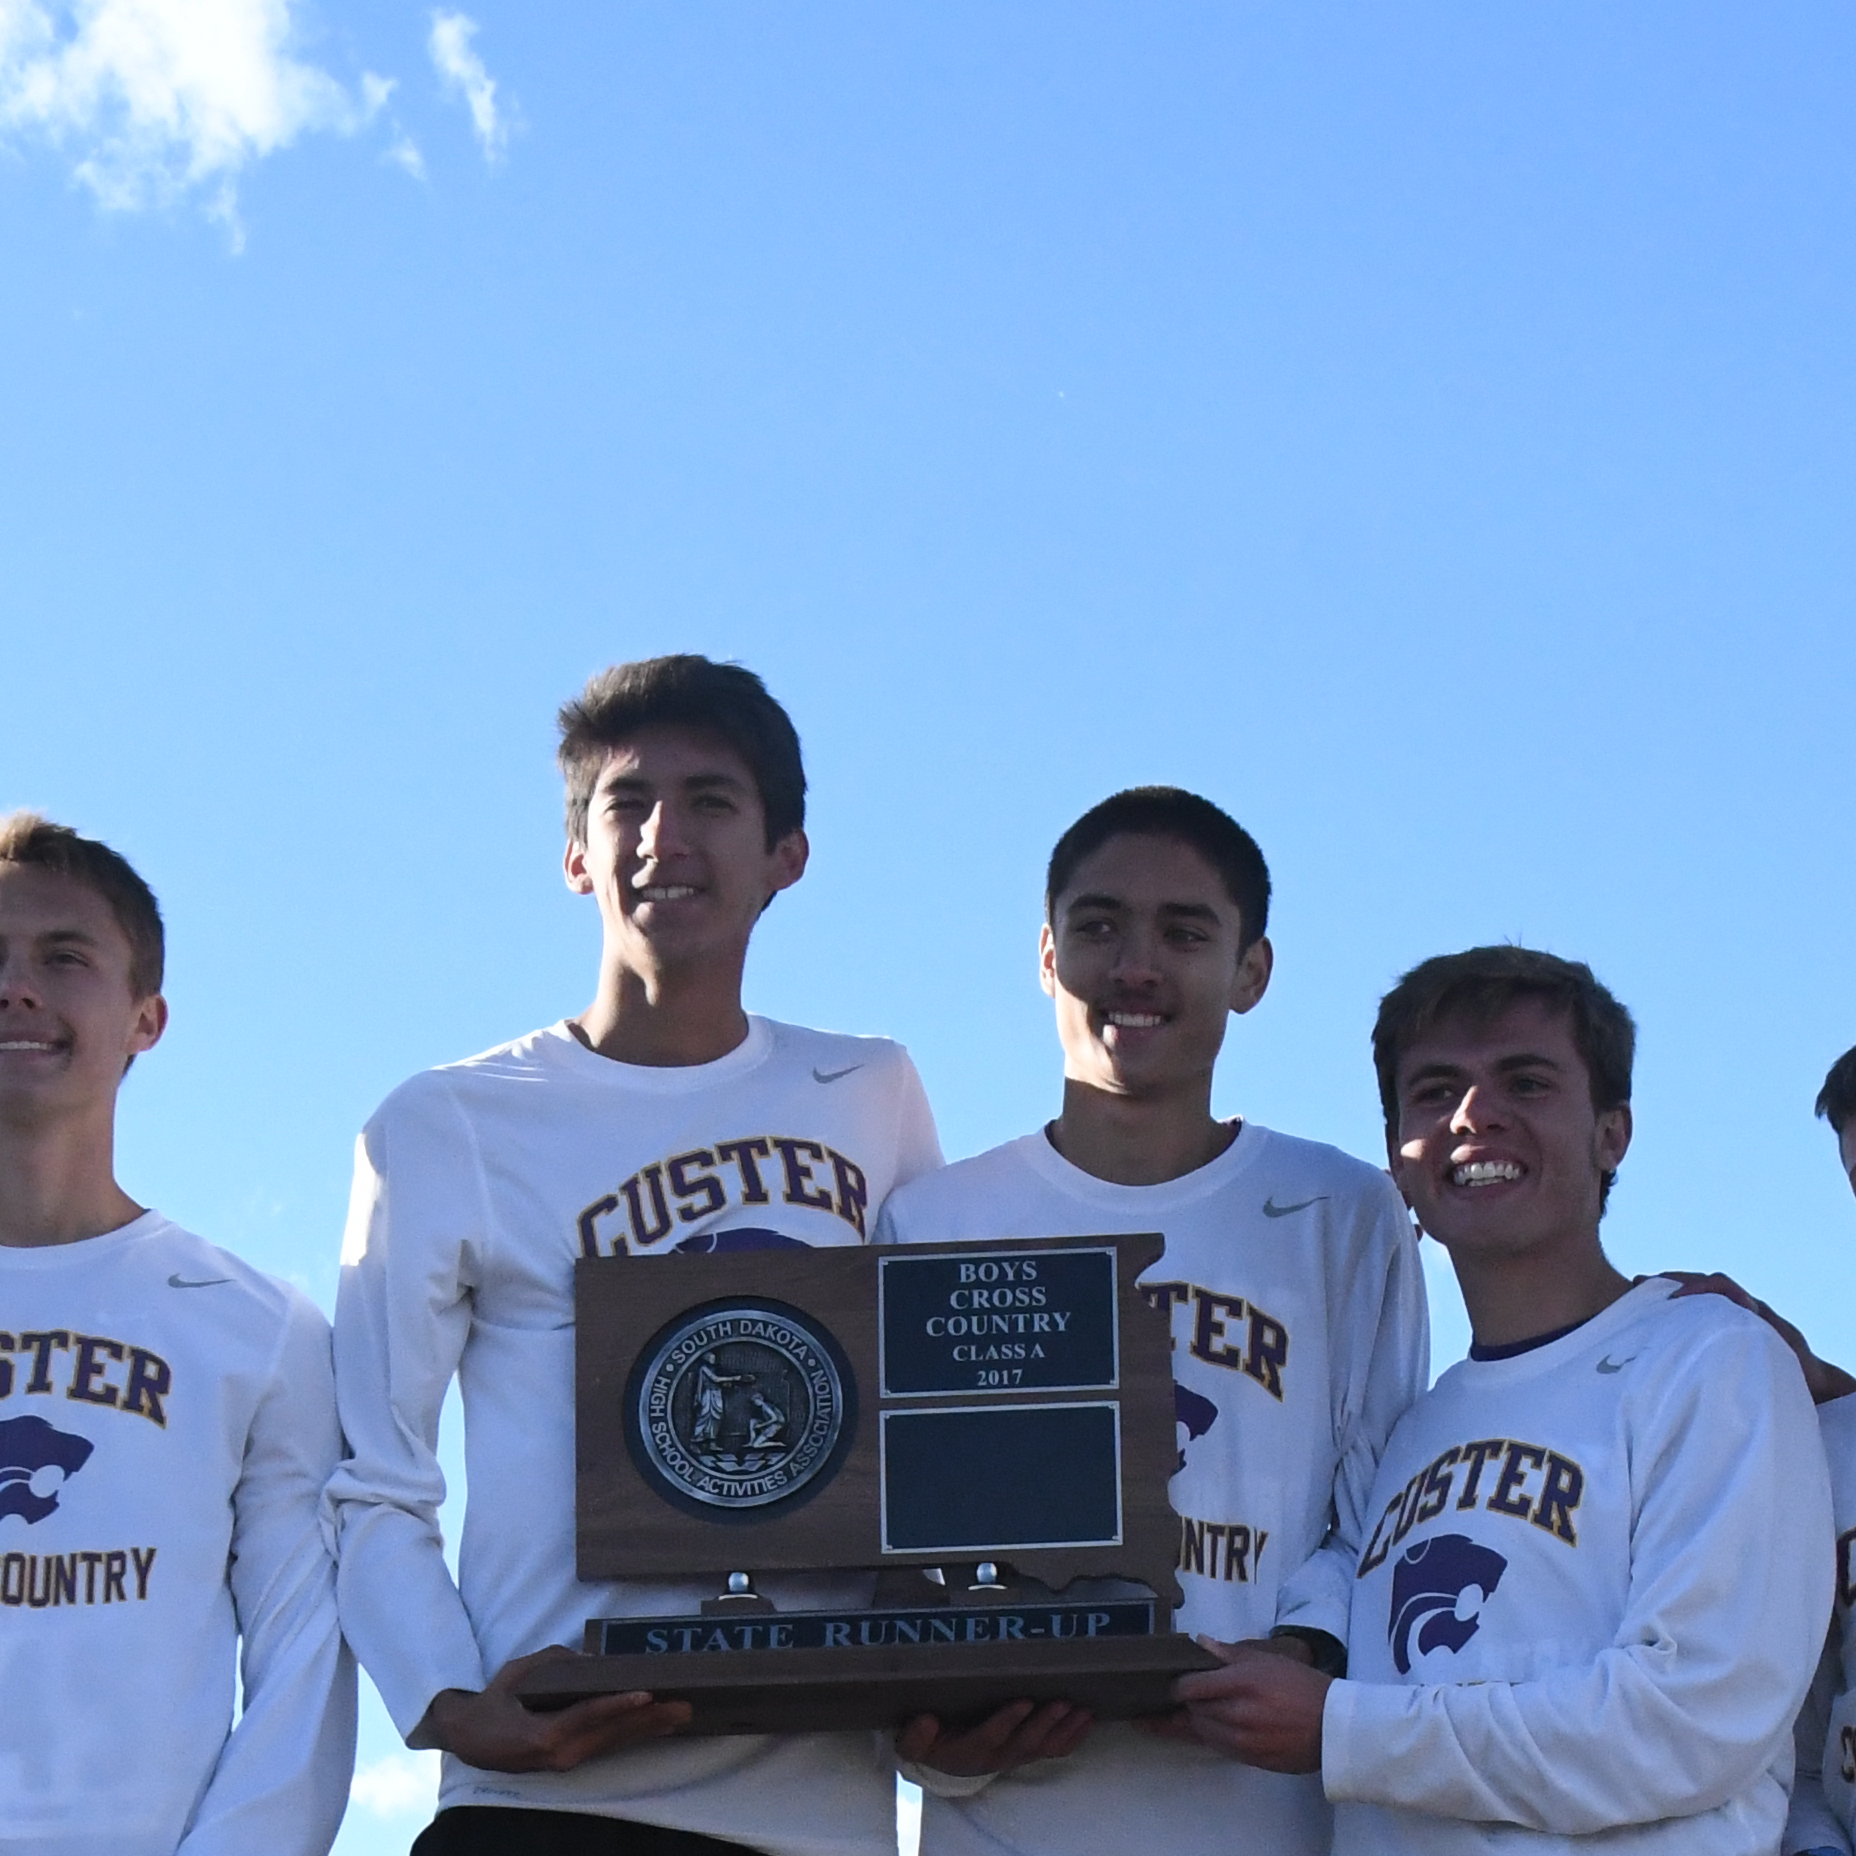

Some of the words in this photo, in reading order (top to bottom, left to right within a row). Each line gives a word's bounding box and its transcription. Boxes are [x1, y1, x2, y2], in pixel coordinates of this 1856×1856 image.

[577, 1135, 867, 1257] CUSTER
[959, 1260, 1037, 1283] BOYS
[950, 1287, 1046, 1310] CROSS
[671, 1321, 732, 1364] SOUTH
[739, 1320, 808, 1361] DAKOTA
[926, 1312, 1071, 1337] COUNTRY
[1136, 1280, 1290, 1403] TER
[952, 1344, 1026, 1362] CLASS
[1030, 1342, 1046, 1359] A
[650, 1375, 671, 1417] HIGH
[977, 1369, 1023, 1386] 2017
[789, 1369, 832, 1477] ASSOCIATION
[652, 1421, 694, 1482] SCHOOL
[696, 1470, 788, 1496] ACTIVITIES
[1356, 1438, 1584, 1579] CUSTER
[645, 1623, 794, 1653] STATE
[824, 1613, 1111, 1647] RUNNER-UP
